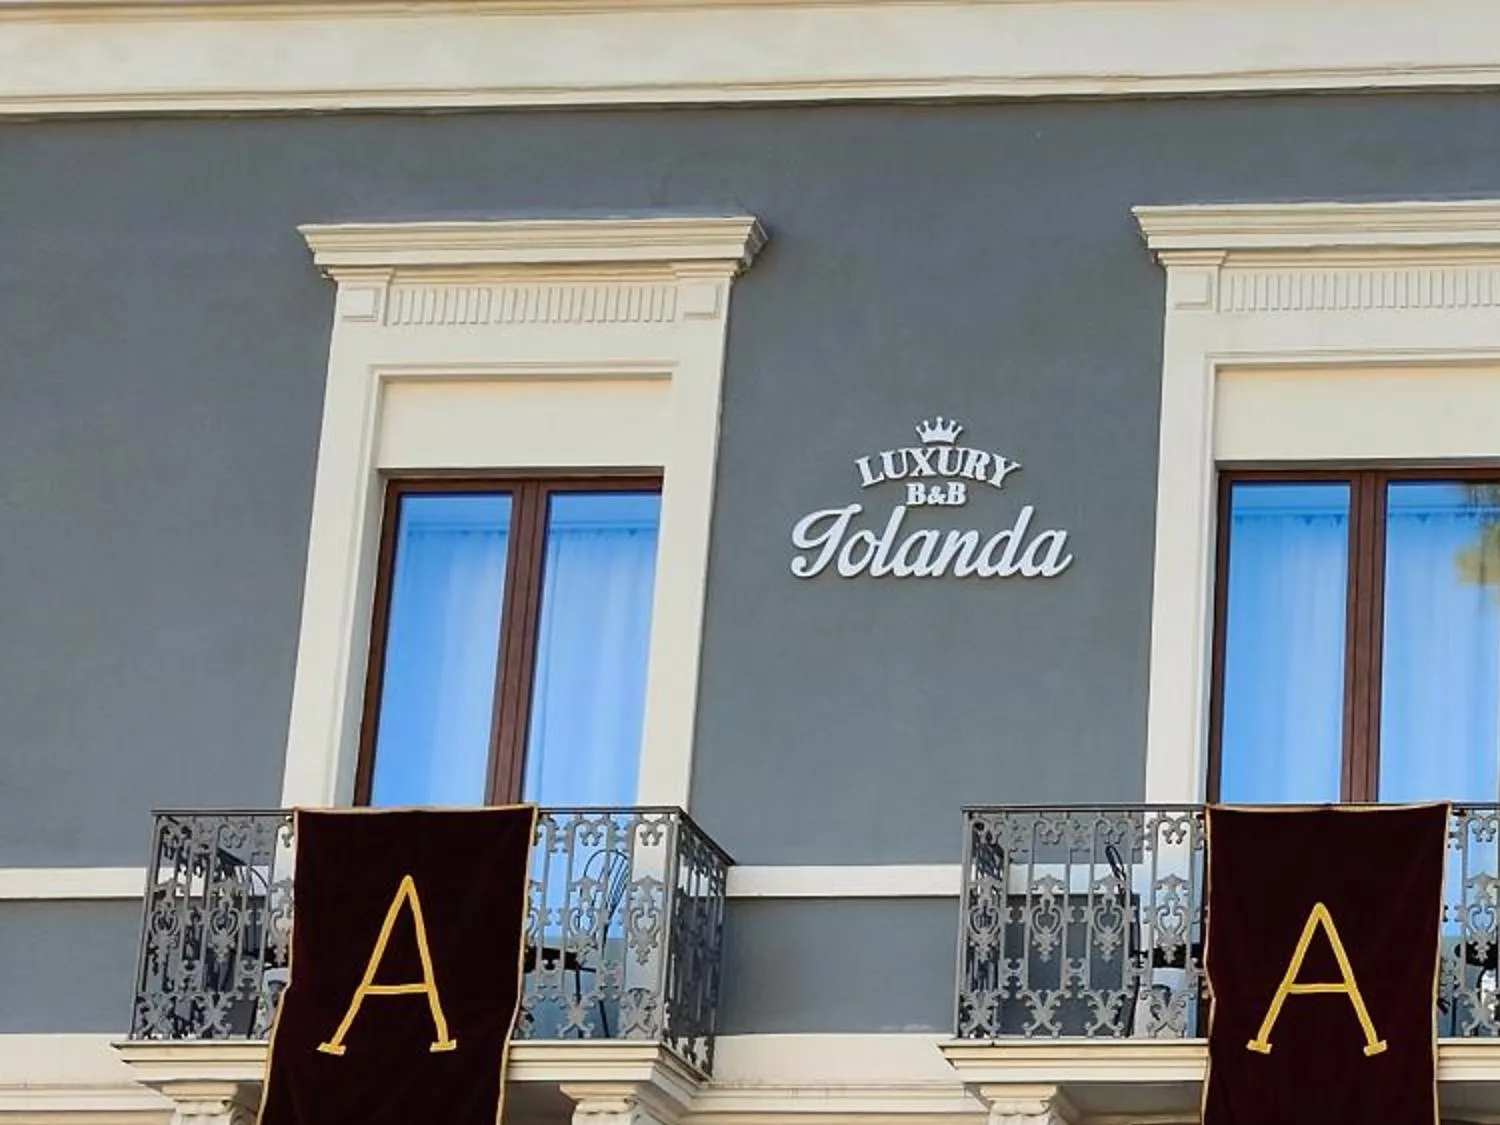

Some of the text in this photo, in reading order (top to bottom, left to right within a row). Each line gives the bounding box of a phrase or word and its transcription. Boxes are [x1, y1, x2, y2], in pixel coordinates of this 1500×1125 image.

[854, 446, 1022, 489] LUXURY
[905, 481, 968, 505] B&B
[316, 875, 457, 1055] A
[1246, 902, 1388, 1056] A
